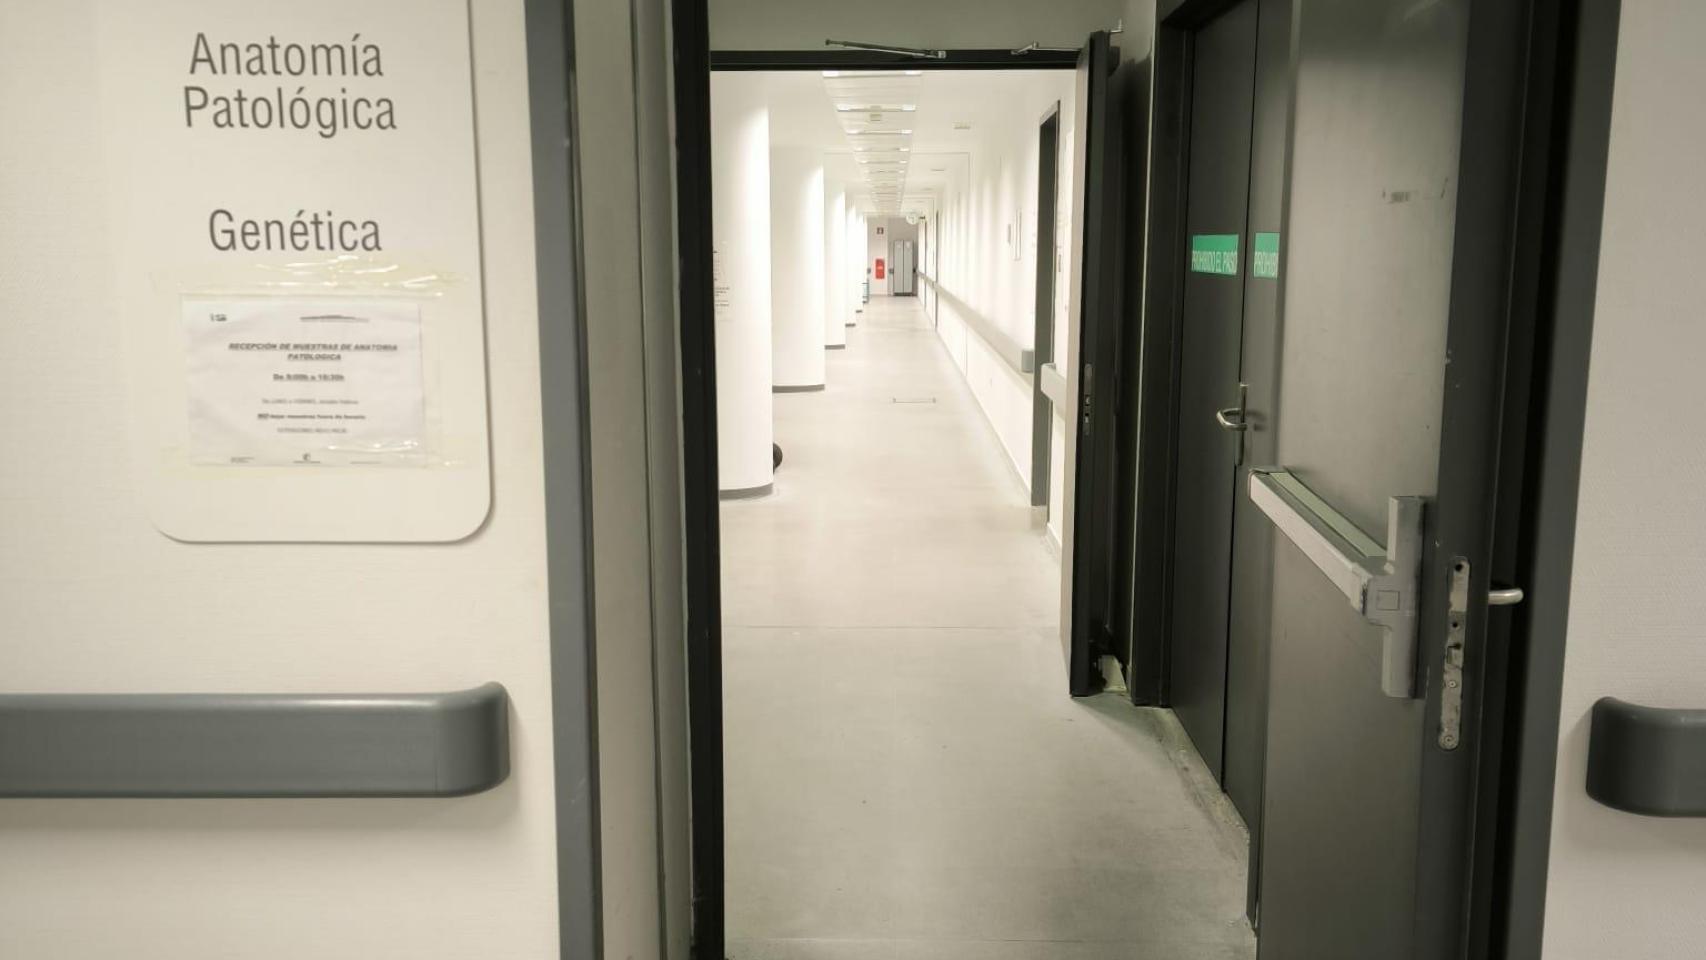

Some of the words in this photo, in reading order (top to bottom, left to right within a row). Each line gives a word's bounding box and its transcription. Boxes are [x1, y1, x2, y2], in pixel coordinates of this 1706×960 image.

[190, 32, 384, 76] Anatomía
[184, 86, 397, 138] Patológica
[209, 209, 383, 252] Genética
[292, 343, 339, 351] MUESTRAS
[341, 343, 352, 351] DE
